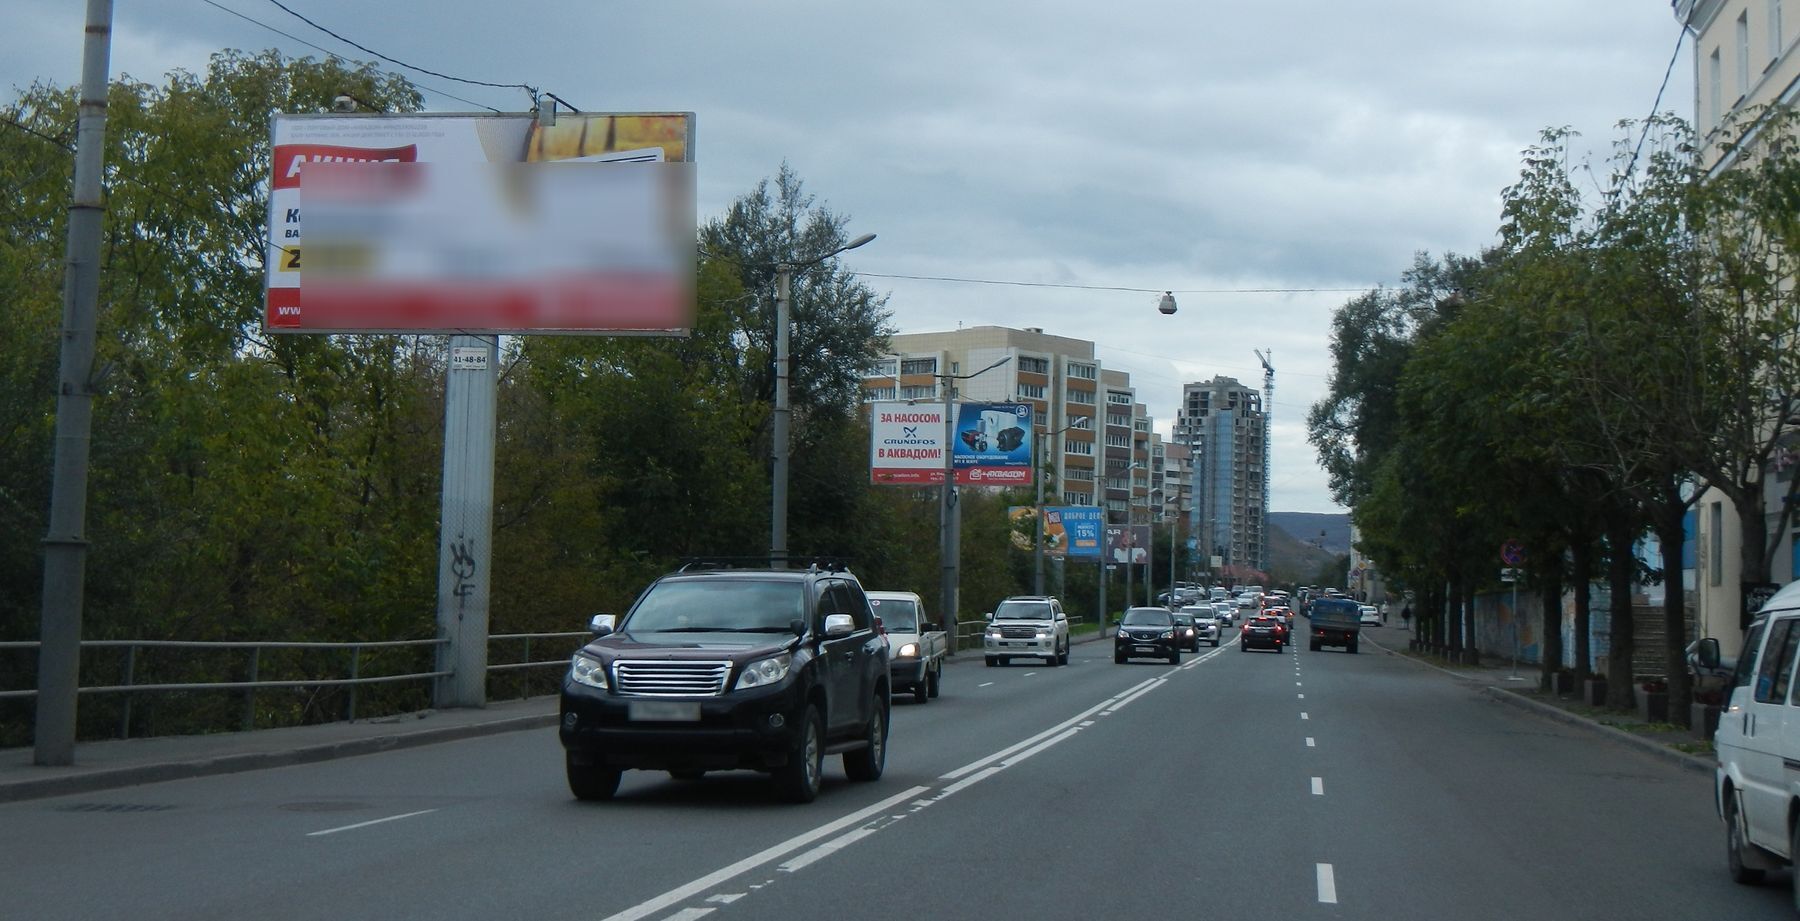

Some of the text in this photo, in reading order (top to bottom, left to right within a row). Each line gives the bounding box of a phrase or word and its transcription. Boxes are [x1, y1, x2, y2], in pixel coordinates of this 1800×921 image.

[881, 413, 941, 423] ЗА НАСОСОМ
[878, 448, 942, 460] В АКВАДОМ!
[1077, 529, 1095, 537] 15%
